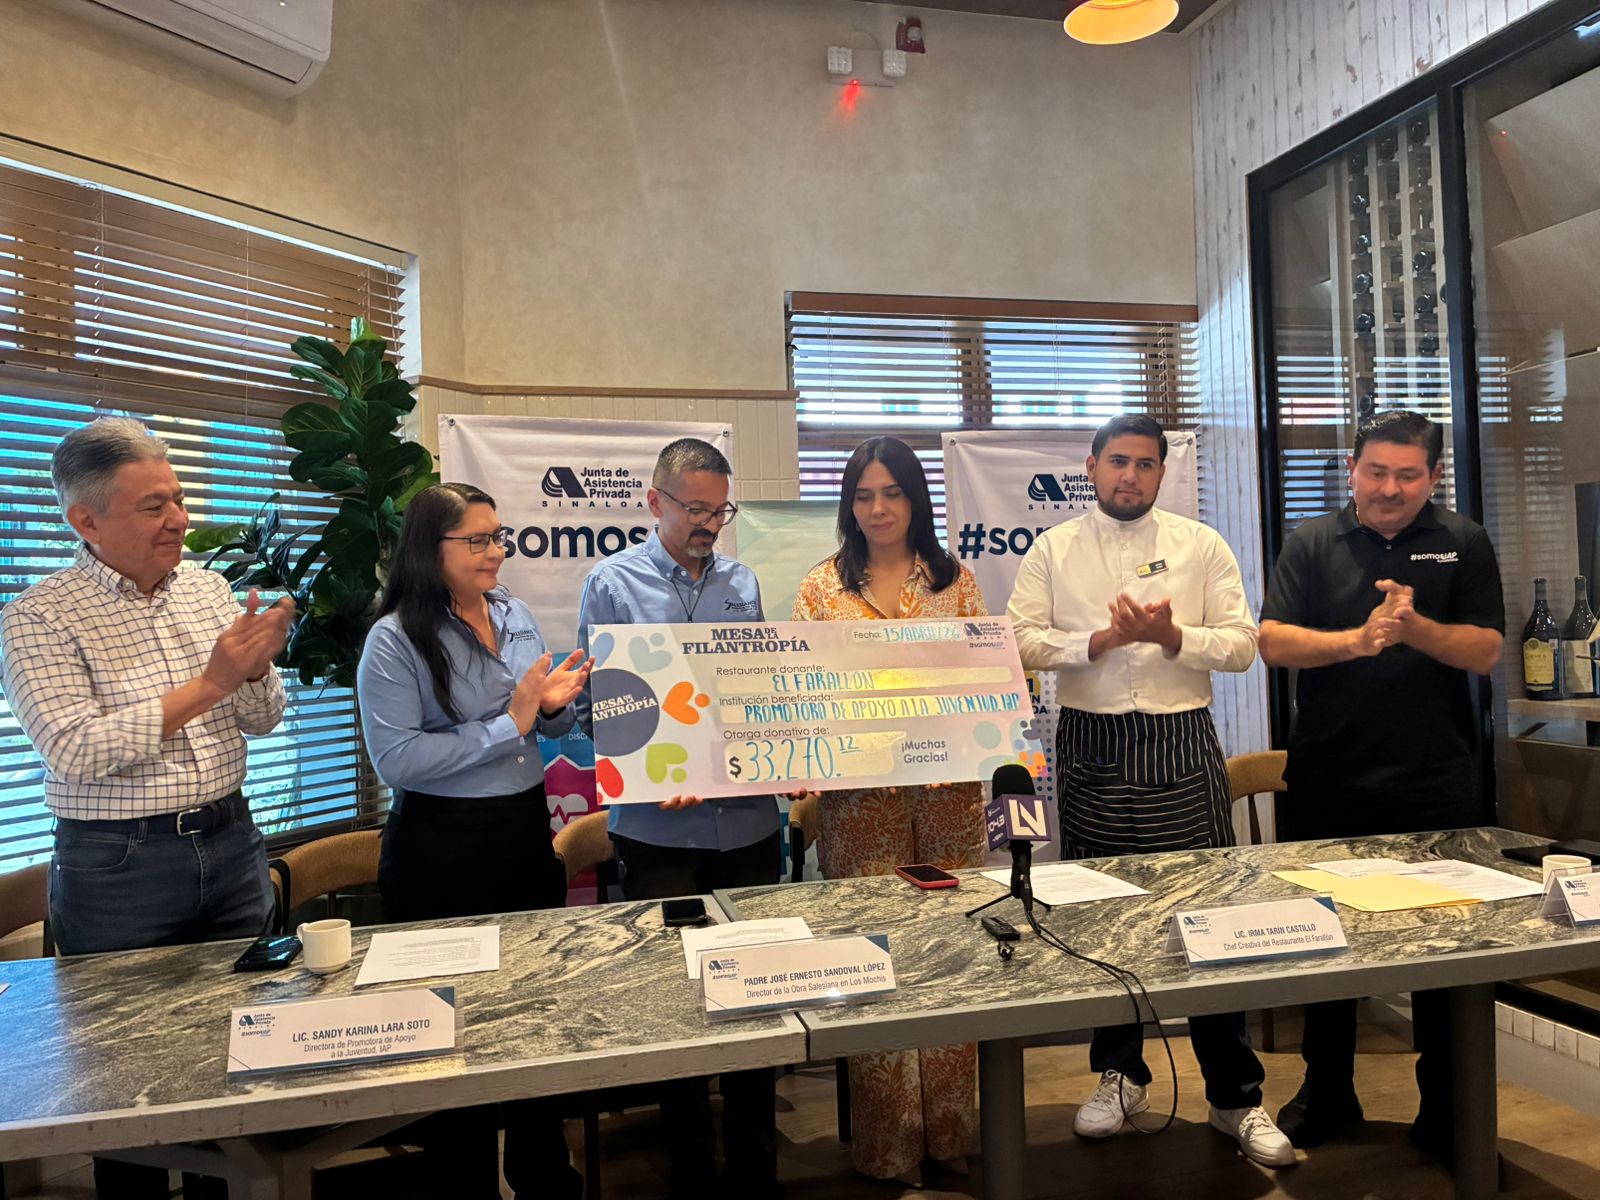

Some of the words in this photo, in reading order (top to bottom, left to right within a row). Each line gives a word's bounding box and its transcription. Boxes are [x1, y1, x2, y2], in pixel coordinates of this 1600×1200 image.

[581, 467, 612, 477] Junta
[616, 468, 629, 477] de
[1061, 473, 1088, 482] Junta
[584, 478, 642, 488] Asistencia
[590, 488, 631, 498] Privada
[711, 628, 765, 640] MESA
[854, 631, 882, 639] Fecha:
[682, 636, 810, 655] FILANTROPÍA
[716, 666, 776, 676] Restaurante
[779, 664, 826, 674] donante:
[772, 674, 790, 692] EL
[719, 695, 769, 706] Institución
[770, 693, 834, 704] beneficiada:
[744, 702, 827, 724] PROMOTORA
[831, 702, 848, 720] DE
[852, 698, 896, 719] APOYO
[901, 698, 910, 716] A
[723, 730, 761, 741] Otorga
[764, 727, 811, 738] donativo
[813, 726, 830, 736] de:
[901, 739, 946, 753] ¡Muchas
[903, 752, 948, 764] Gracias!
[729, 756, 742, 778] $
[1234, 930, 1247, 939] LIC.
[1248, 928, 1265, 937] IRMA
[1286, 924, 1316, 933] CASTILLO
[1224, 943, 1237, 951] Chef
[1238, 940, 1262, 950] Creativa
[1262, 939, 1271, 947] del
[1272, 936, 1304, 946] Restaurante
[744, 977, 768, 986] PADRE
[769, 974, 788, 983] JOSÉ
[790, 970, 822, 982] ERNESTO
[824, 966, 862, 977] SANDOVAL
[863, 962, 886, 973] LÓPEZ
[746, 989, 772, 998] Director
[774, 987, 782, 995] de
[783, 986, 790, 994] la
[791, 985, 807, 993] Obra
[808, 981, 839, 991] Salesiana
[850, 978, 862, 986] Los
[863, 975, 887, 985] Mochis
[292, 1031, 310, 1042] LIC.
[312, 1027, 344, 1041] SANDY
[345, 1025, 379, 1036] KARINA
[381, 1022, 405, 1033] LARA
[406, 1019, 430, 1030] SOTO
[304, 1041, 336, 1053] Directora
[337, 1040, 346, 1049] de
[347, 1036, 383, 1048] Promotora
[384, 1036, 393, 1044] de
[394, 1033, 416, 1044] Apoyo
[336, 1049, 343, 1058] la
[379, 1044, 392, 1053] IAP
